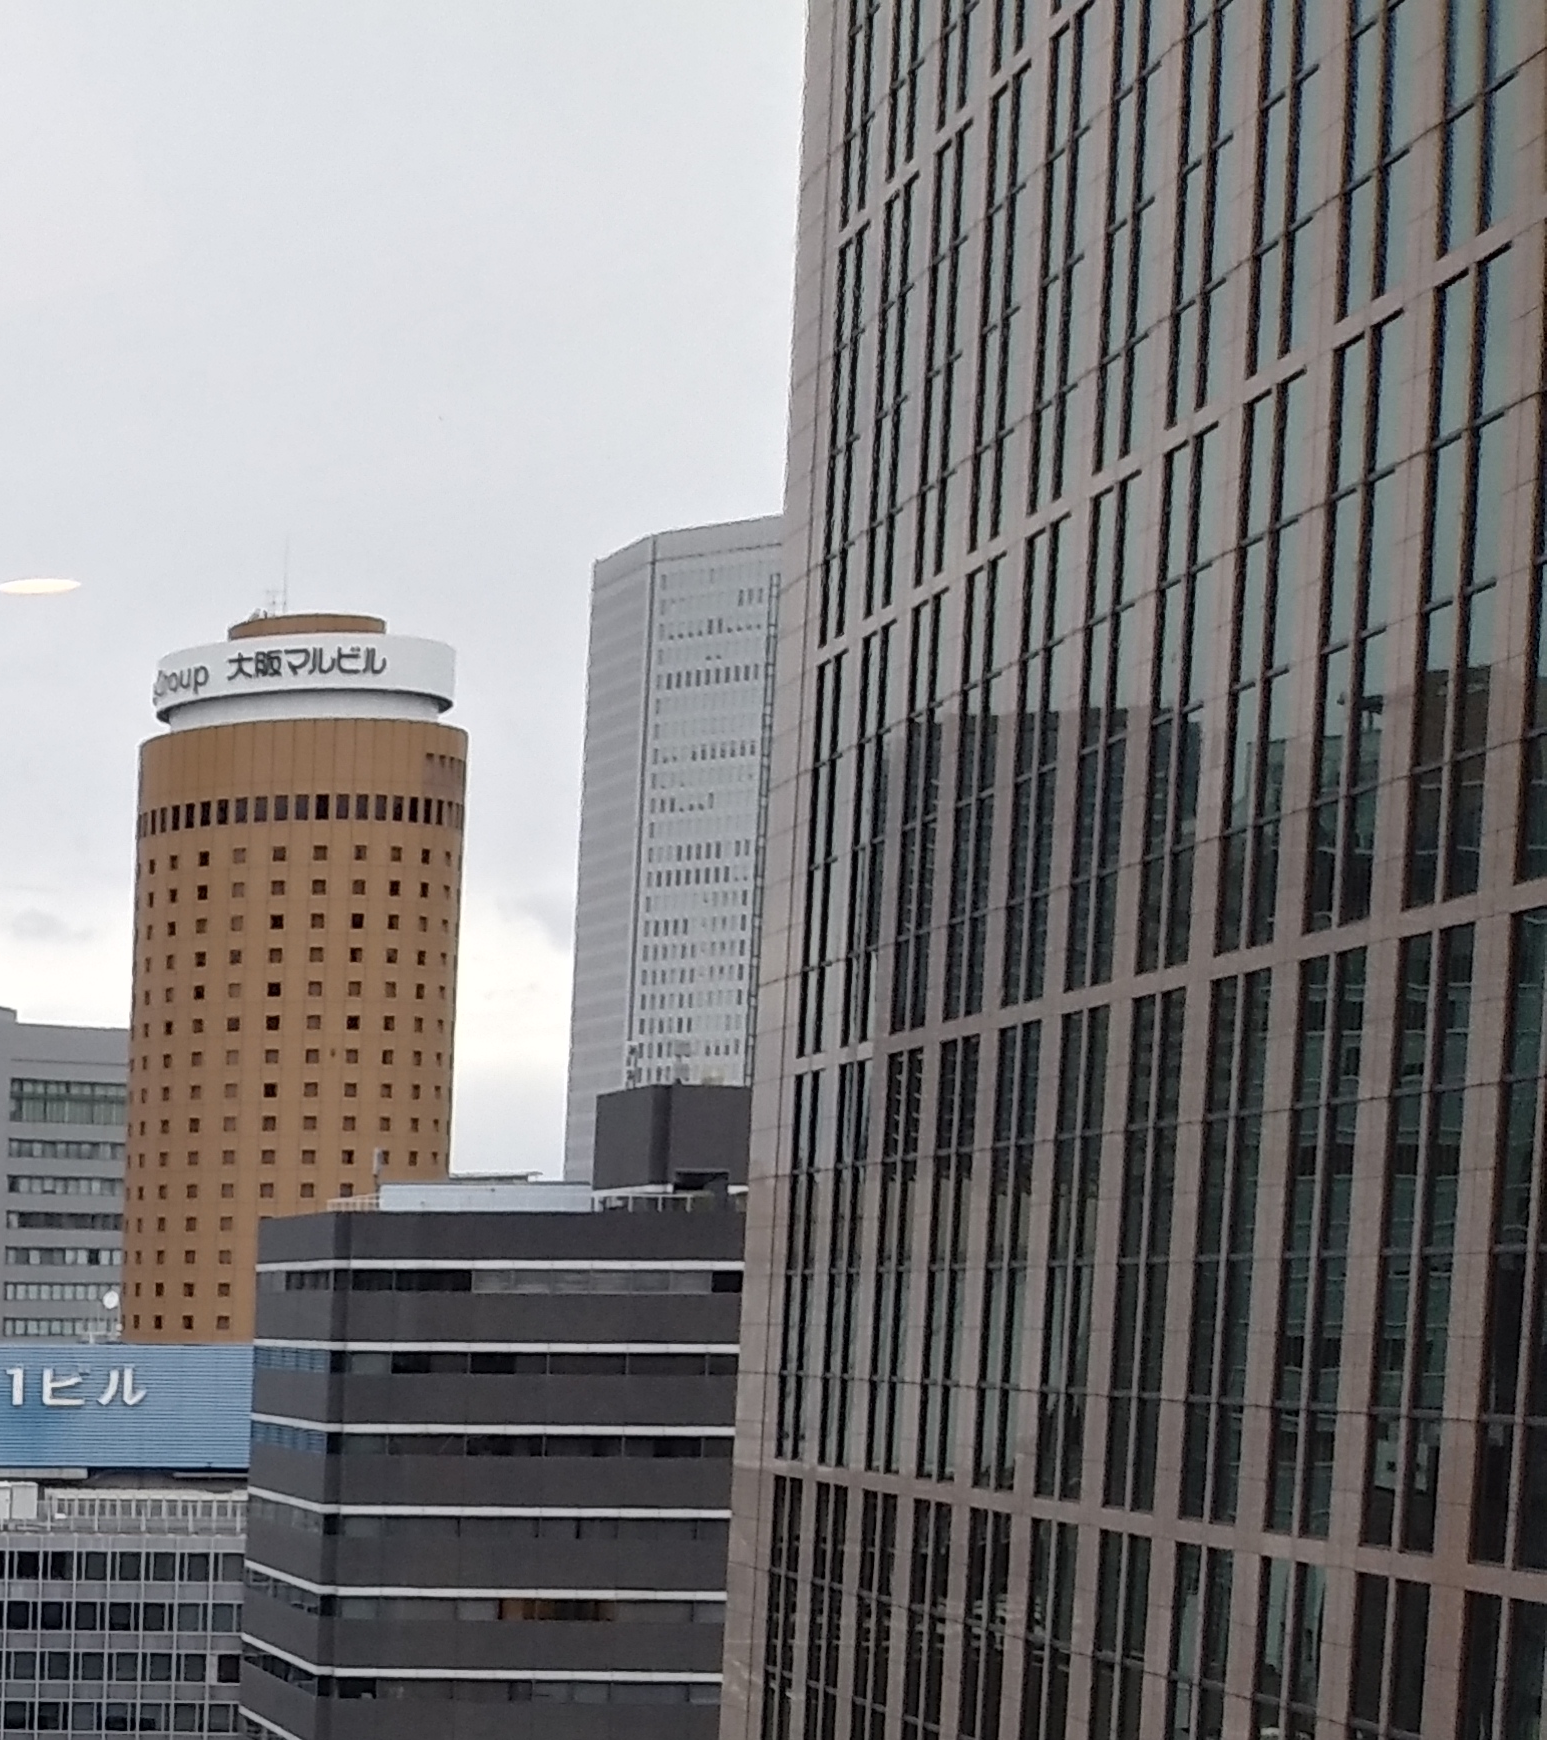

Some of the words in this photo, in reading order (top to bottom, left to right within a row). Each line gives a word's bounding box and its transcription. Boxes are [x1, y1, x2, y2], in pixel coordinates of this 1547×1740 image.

[227, 645, 388, 682] 大阪マルビル
